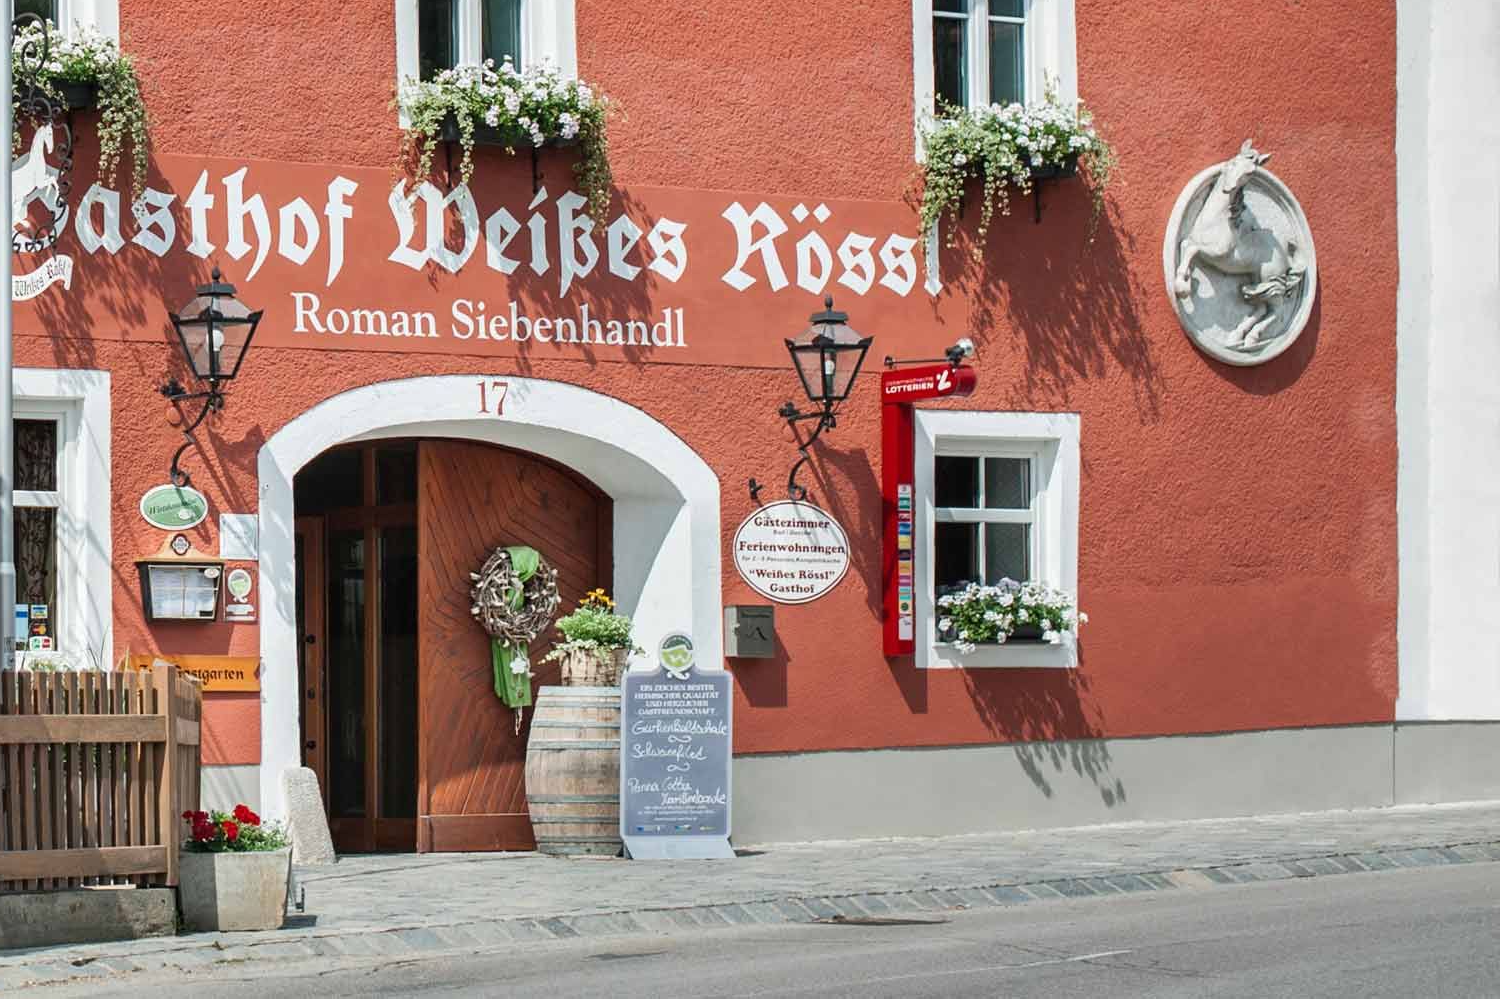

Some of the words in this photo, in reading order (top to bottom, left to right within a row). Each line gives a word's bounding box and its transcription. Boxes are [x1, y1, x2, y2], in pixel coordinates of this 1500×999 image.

[387, 177, 688, 298] Weißes
[290, 292, 440, 338] Roman
[451, 299, 687, 347] Siebenhandl
[885, 382, 934, 394] LOTTERIEN
[476, 382, 509, 416] 17
[754, 517, 830, 529] Gästezimmer
[739, 541, 846, 556] Ferienwohnungen
[770, 583, 814, 593] Gasthof
[682, 691, 719, 699] QUALITÄT
